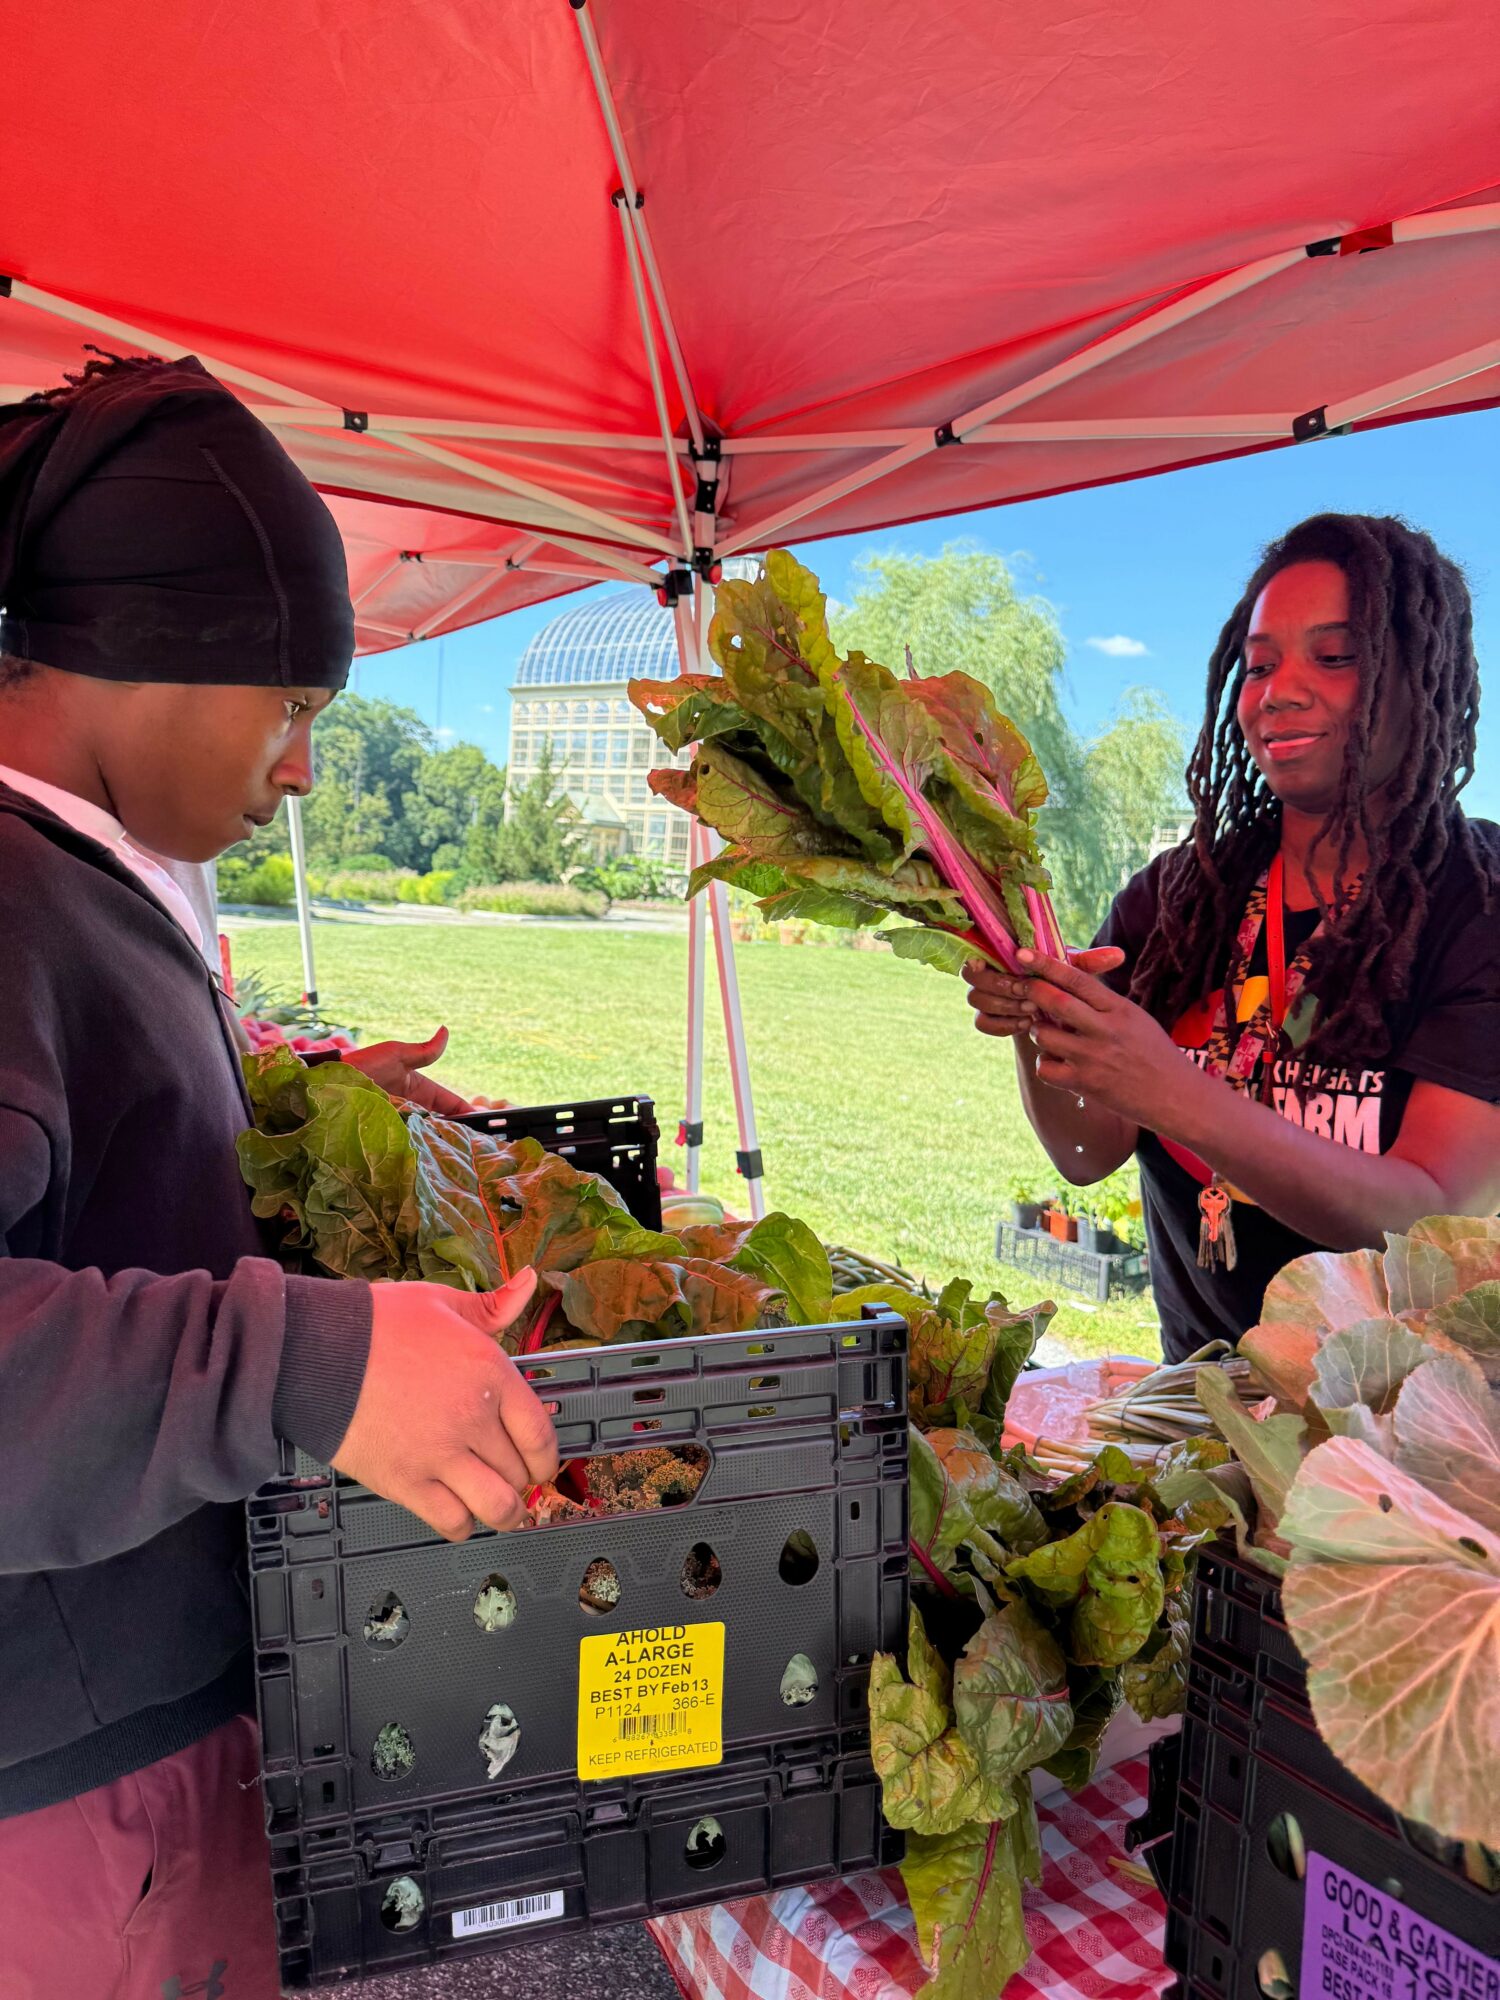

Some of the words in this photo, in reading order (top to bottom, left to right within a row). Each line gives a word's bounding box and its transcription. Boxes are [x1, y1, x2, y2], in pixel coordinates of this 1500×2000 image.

[616, 1625, 686, 1647] AHOLD
[605, 1643, 694, 1667] A-LARGE
[614, 1670, 631, 1683] 24
[636, 1662, 692, 1680] DOZEN
[590, 1687, 632, 1704] BEST
[595, 1702, 641, 1719] P1124
[672, 1693, 715, 1711] 366-E
[589, 1752, 621, 1766] KEEP
[624, 1741, 718, 1763] REFRIGERATED
[1324, 1870, 1383, 1929] GOOD
[1388, 1910, 1402, 1944] &
[1409, 1923, 1500, 2000] GATHER
[1322, 1943, 1348, 1971] CASE
[1351, 1962, 1378, 1990] PACK
